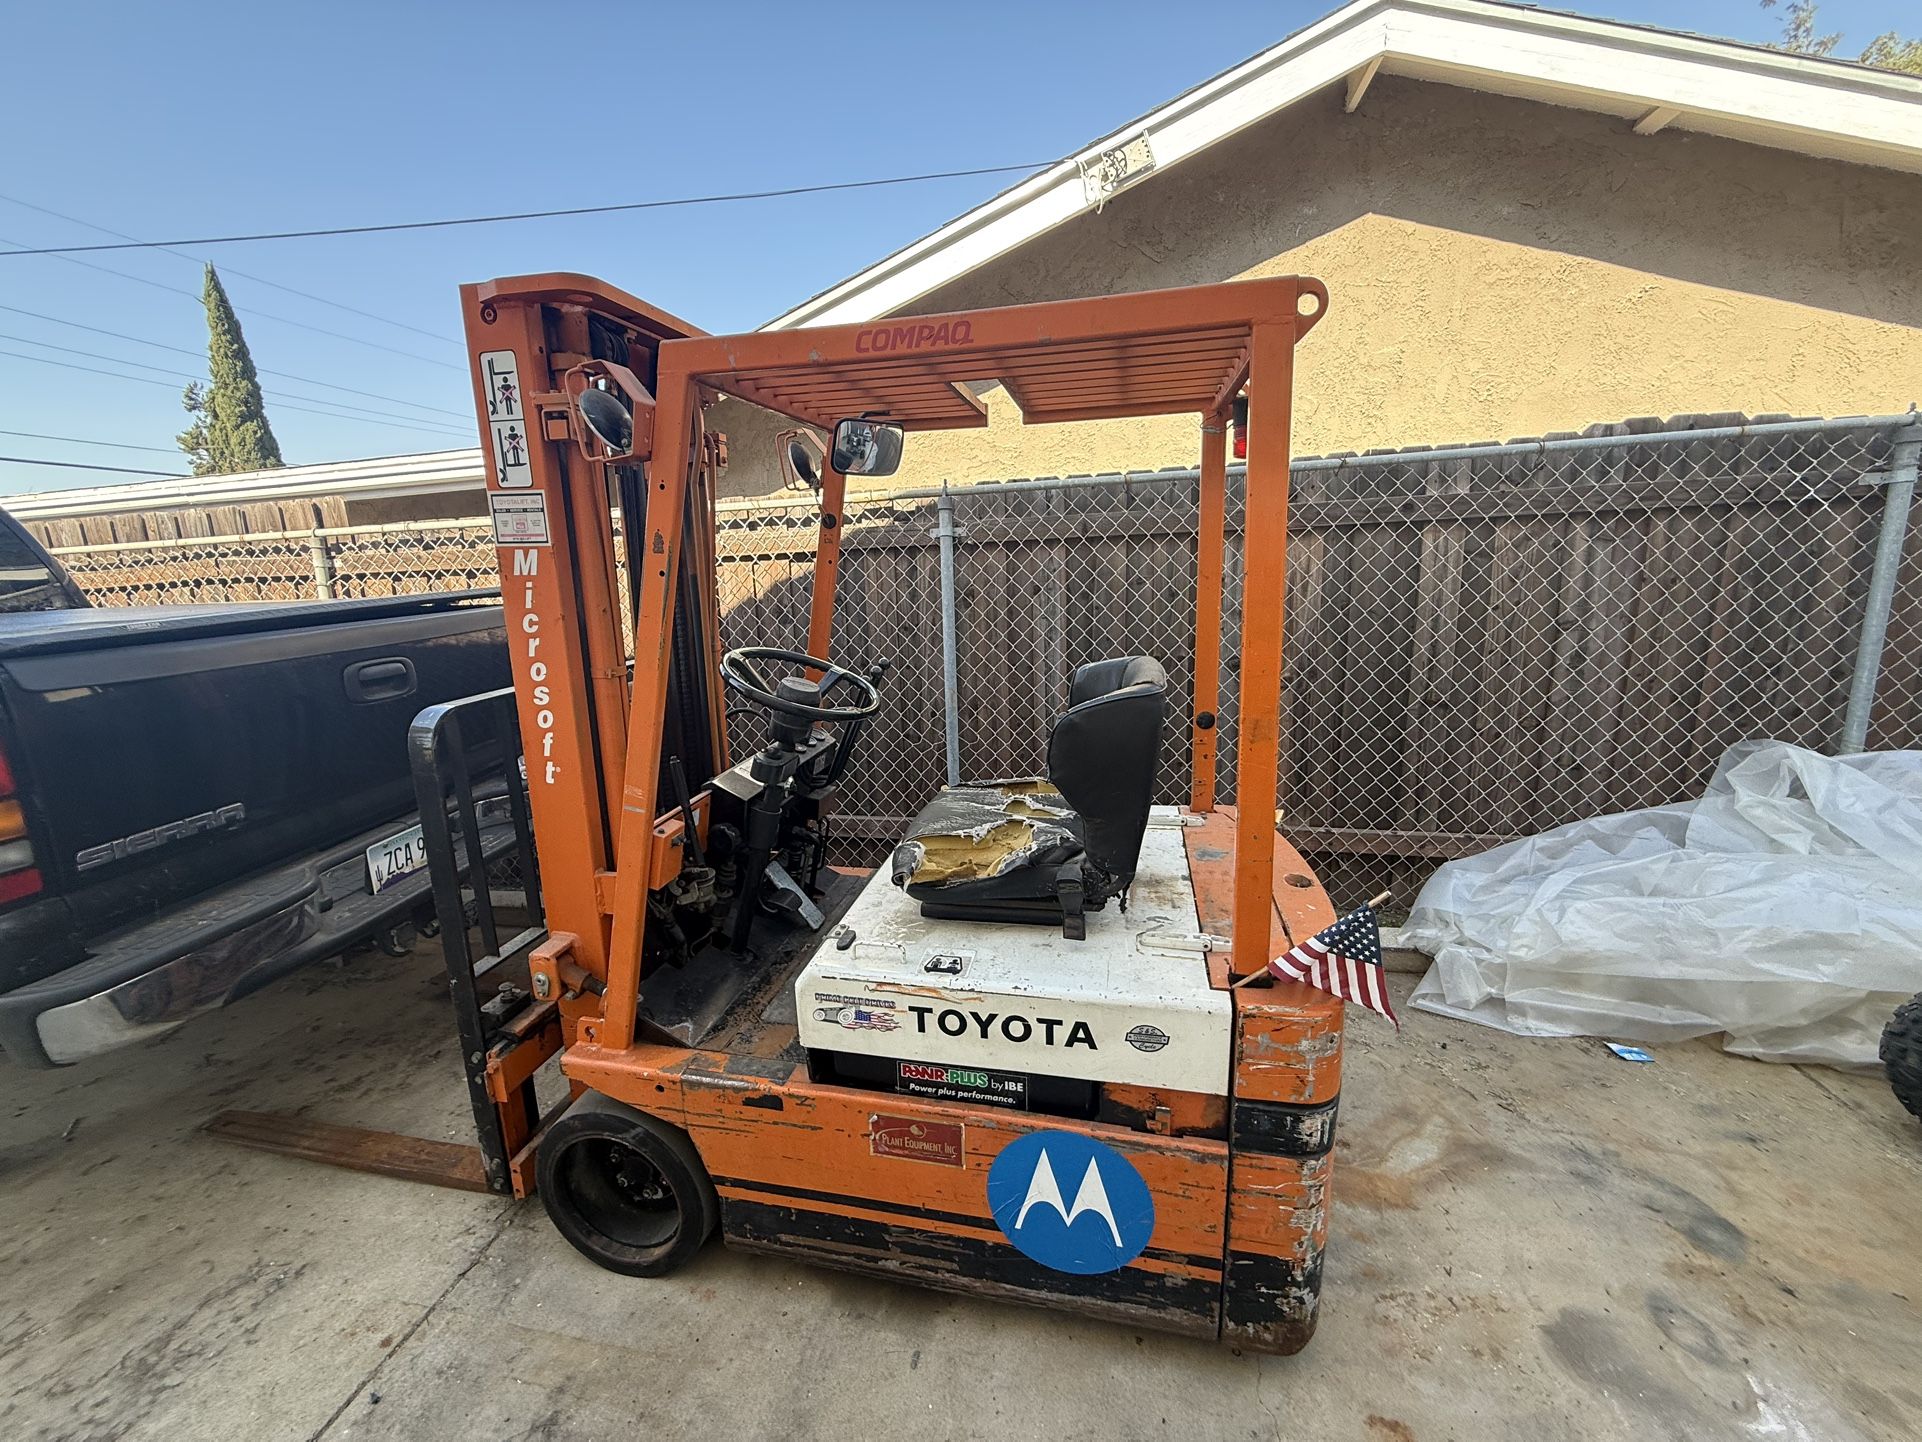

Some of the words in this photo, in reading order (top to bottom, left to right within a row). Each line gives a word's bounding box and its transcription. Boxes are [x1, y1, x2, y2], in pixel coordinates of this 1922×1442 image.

[855, 320, 974, 353] COMPAQ
[513, 549, 555, 785] Microsoft
[76, 802, 246, 872] SIERRA
[384, 842, 414, 876] ZCA
[908, 1005, 1098, 1050] TOYOTA
[909, 1083, 936, 1093] Power
[938, 1087, 956, 1096] plus
[957, 1090, 1016, 1104] performance.
[991, 1079, 1004, 1091] by
[1004, 1081, 1024, 1092] IBE
[881, 1133, 903, 1146] PLANT
